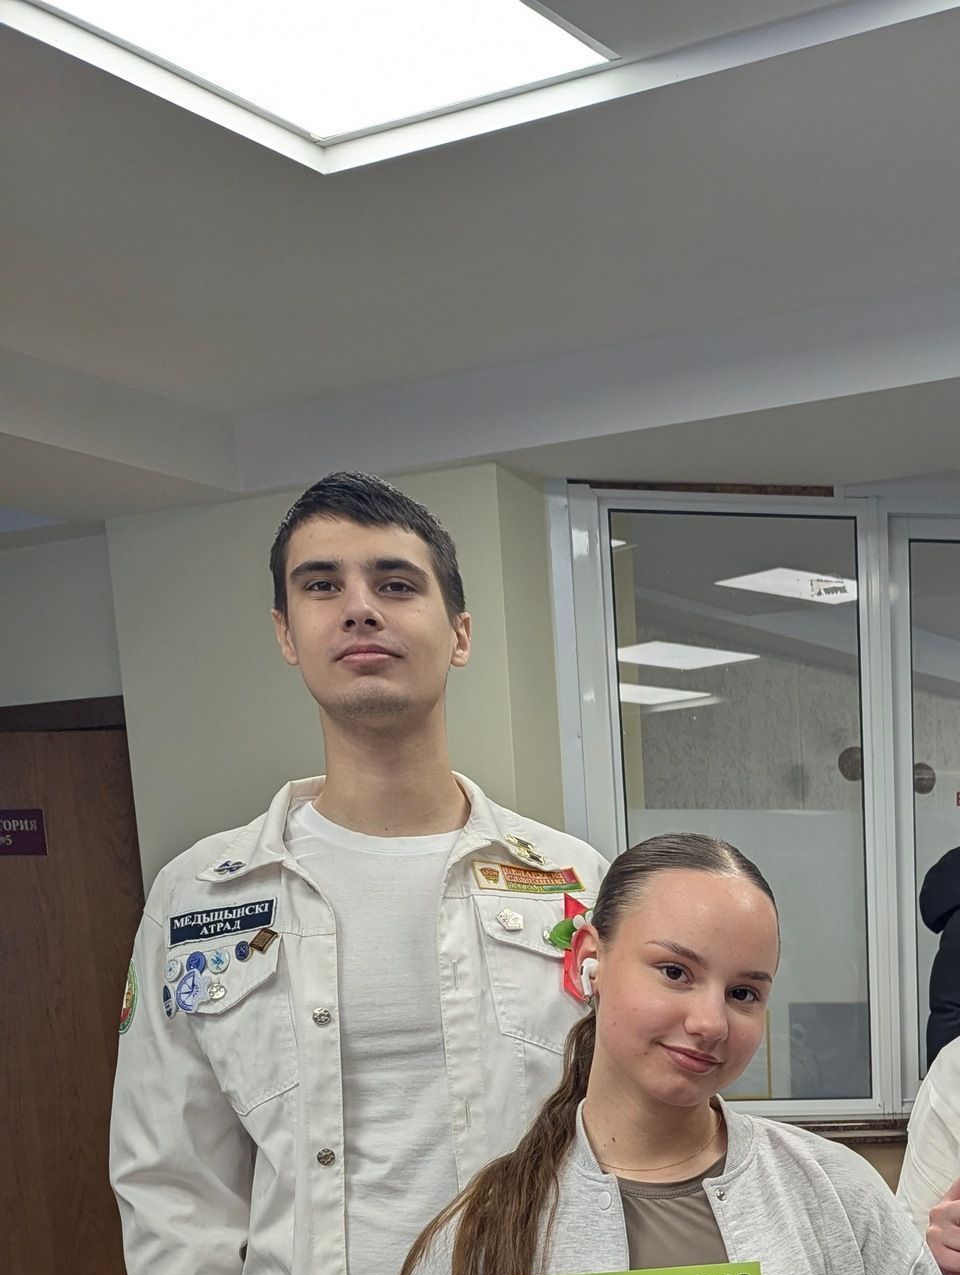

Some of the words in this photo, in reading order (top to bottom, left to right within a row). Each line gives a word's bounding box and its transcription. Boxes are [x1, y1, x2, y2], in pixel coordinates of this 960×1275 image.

[0, 819, 37, 832] ОРИЯ
[173, 902, 270, 929] МЕДЫЦЫНСКІ
[200, 920, 241, 936] АТРАД
